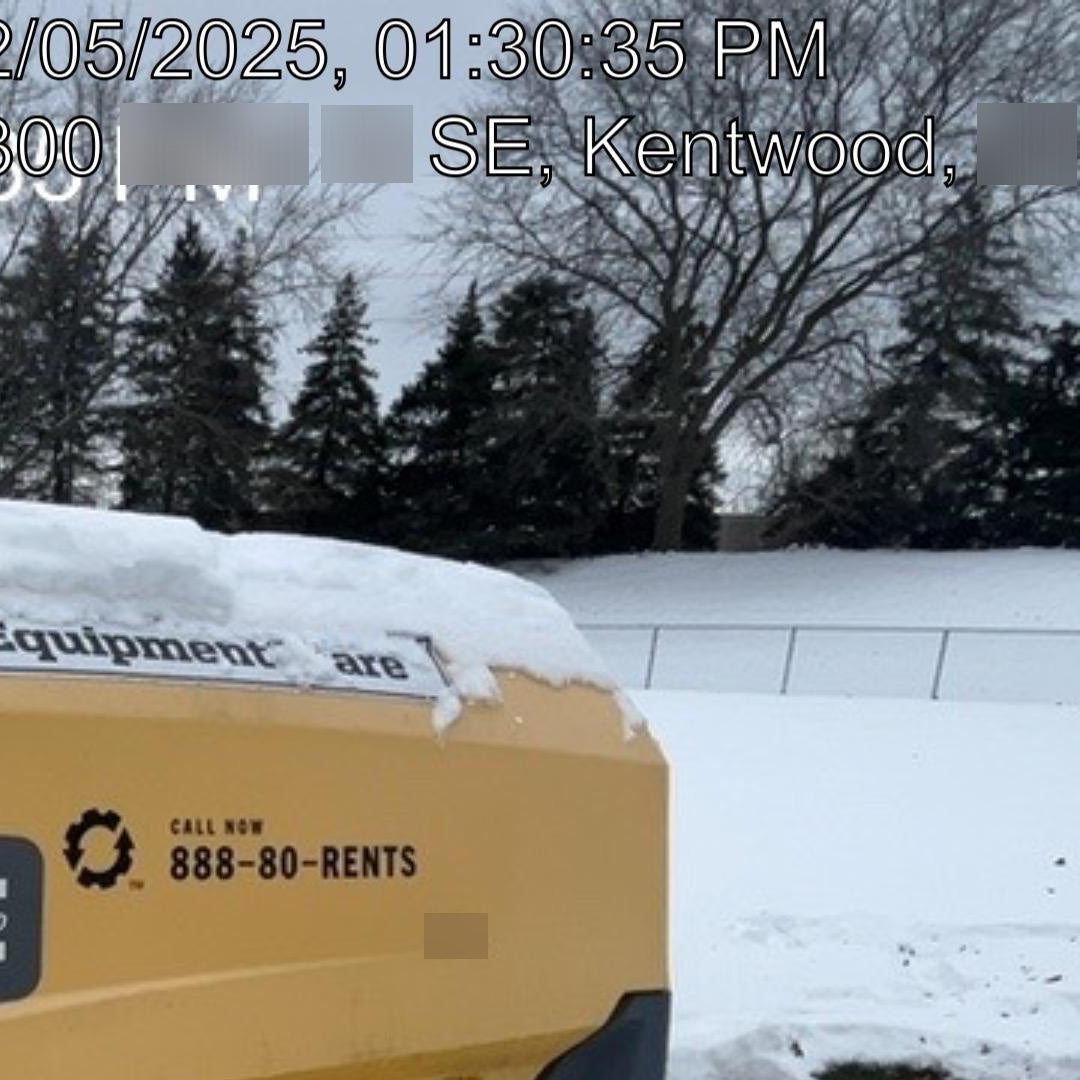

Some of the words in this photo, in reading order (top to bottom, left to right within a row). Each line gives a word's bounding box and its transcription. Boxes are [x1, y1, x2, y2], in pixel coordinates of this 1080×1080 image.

[170, 818, 216, 836] CALL
[224, 818, 264, 836] NOW
[169, 844, 418, 881] 888-80-RENTS
